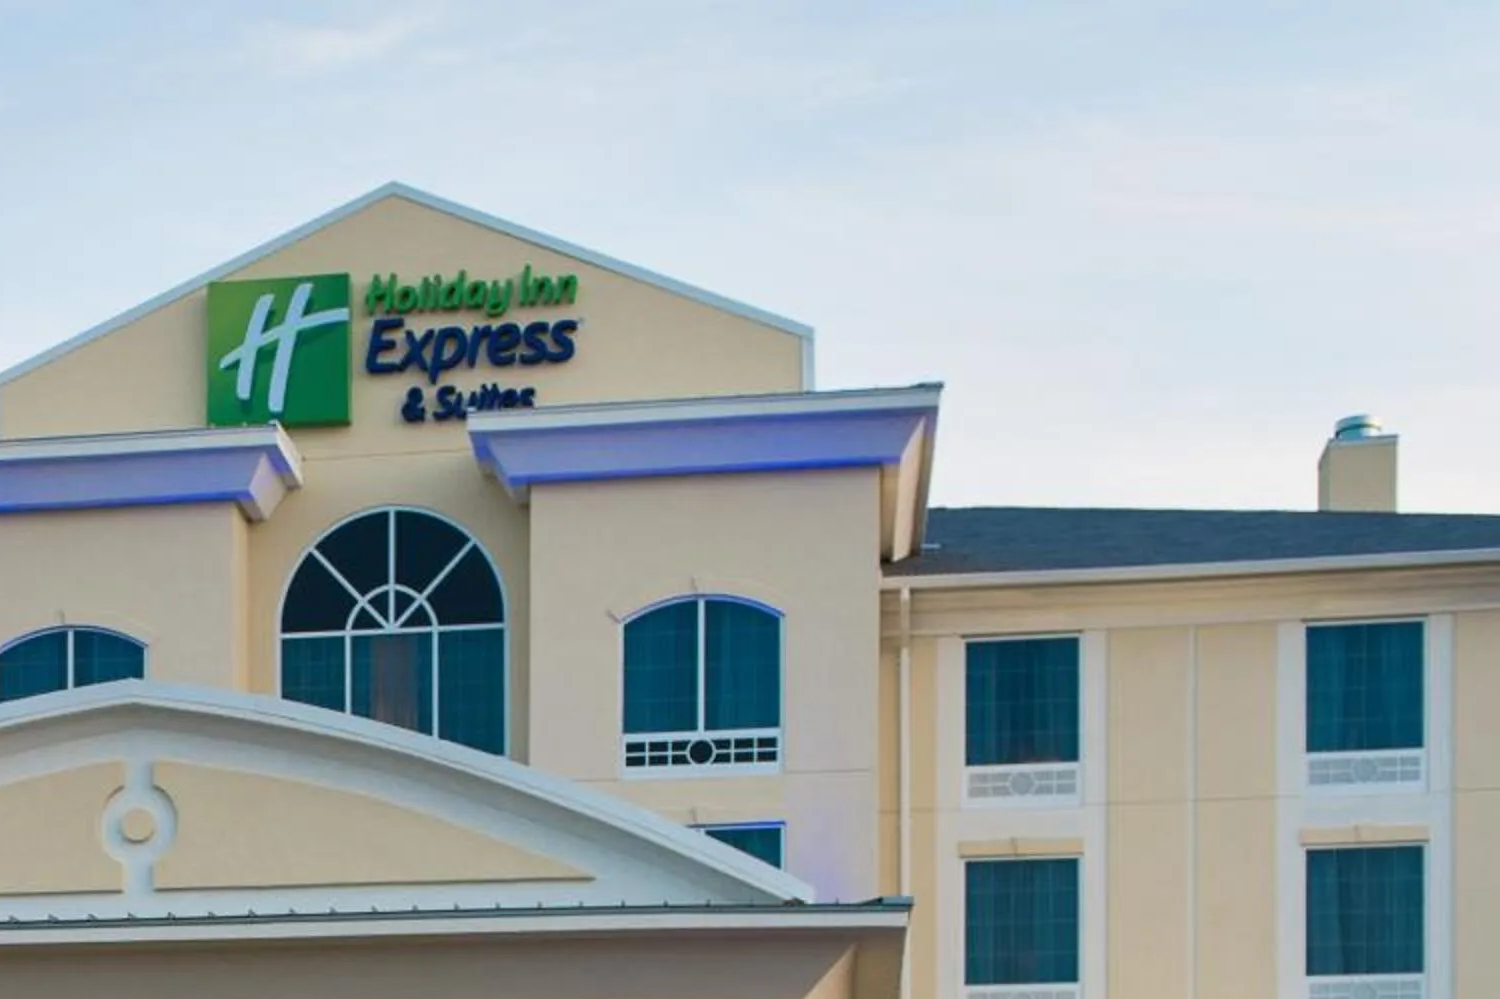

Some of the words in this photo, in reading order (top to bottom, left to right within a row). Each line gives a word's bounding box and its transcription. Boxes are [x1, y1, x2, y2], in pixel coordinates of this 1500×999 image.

[365, 269, 513, 318] Holiday
[519, 263, 578, 307] Inn
[219, 282, 349, 413] H
[365, 317, 578, 385] Express
[402, 386, 426, 423] &
